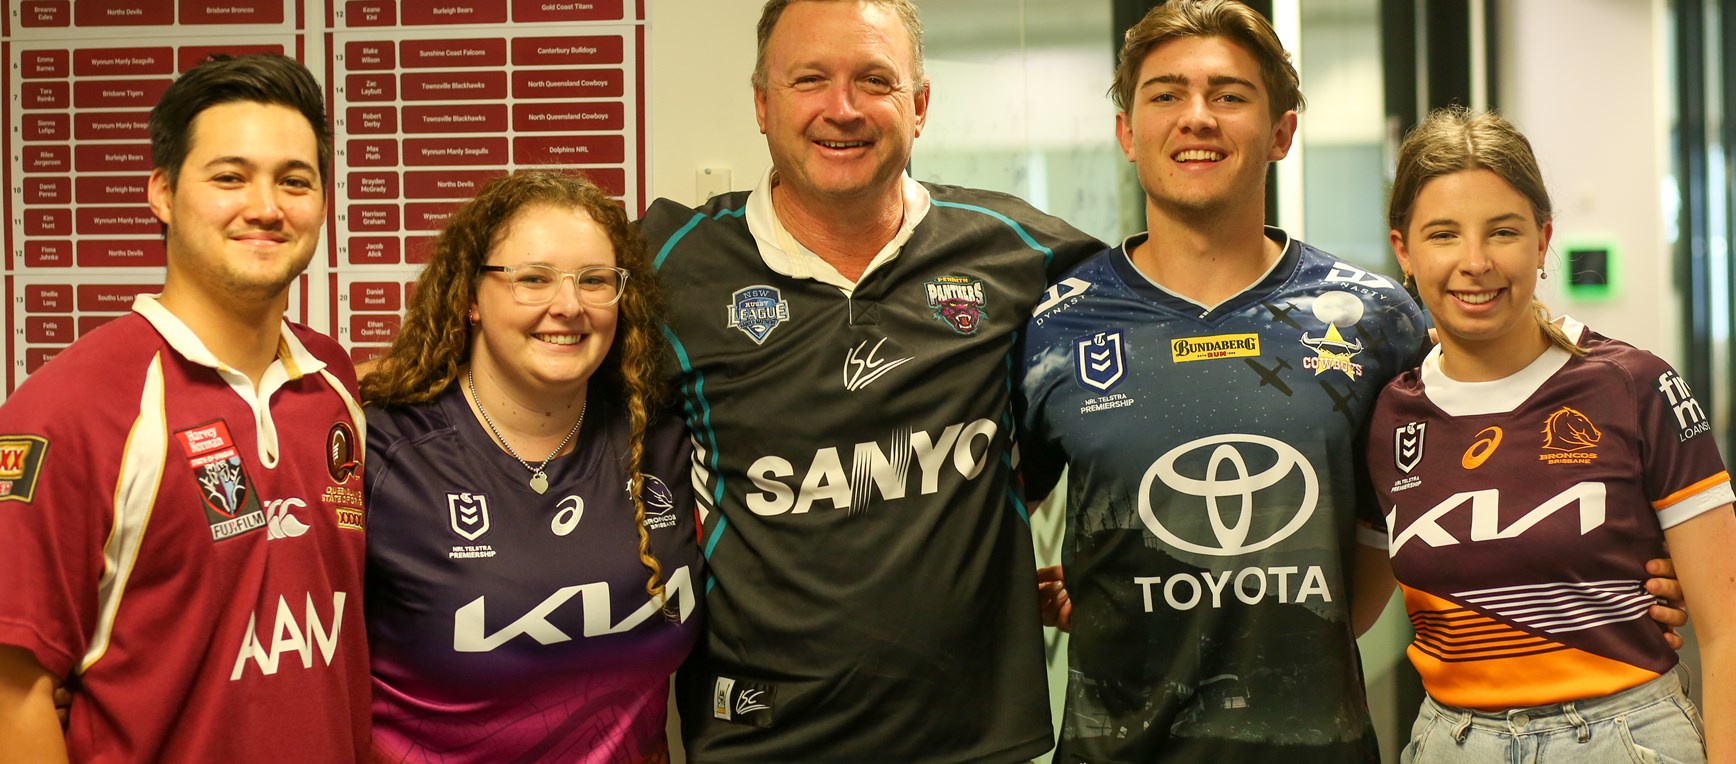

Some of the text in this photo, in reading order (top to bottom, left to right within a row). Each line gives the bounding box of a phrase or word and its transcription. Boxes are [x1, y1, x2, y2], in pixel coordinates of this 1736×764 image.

[743, 290, 770, 299] NSW
[927, 282, 984, 305] PANTHERS
[732, 304, 785, 323] LEAGUE
[1036, 295, 1085, 326] DYNAS
[1174, 338, 1256, 356] BUNDABERG
[1303, 357, 1363, 376] COWBOYS
[1080, 399, 1135, 414] PREMIERSHIP
[1098, 394, 1127, 403] TELSTRA
[185, 428, 217, 442] Harvey
[189, 437, 224, 453] Norman
[746, 418, 998, 517] SANYO
[1134, 566, 1332, 613] TOYOTA
